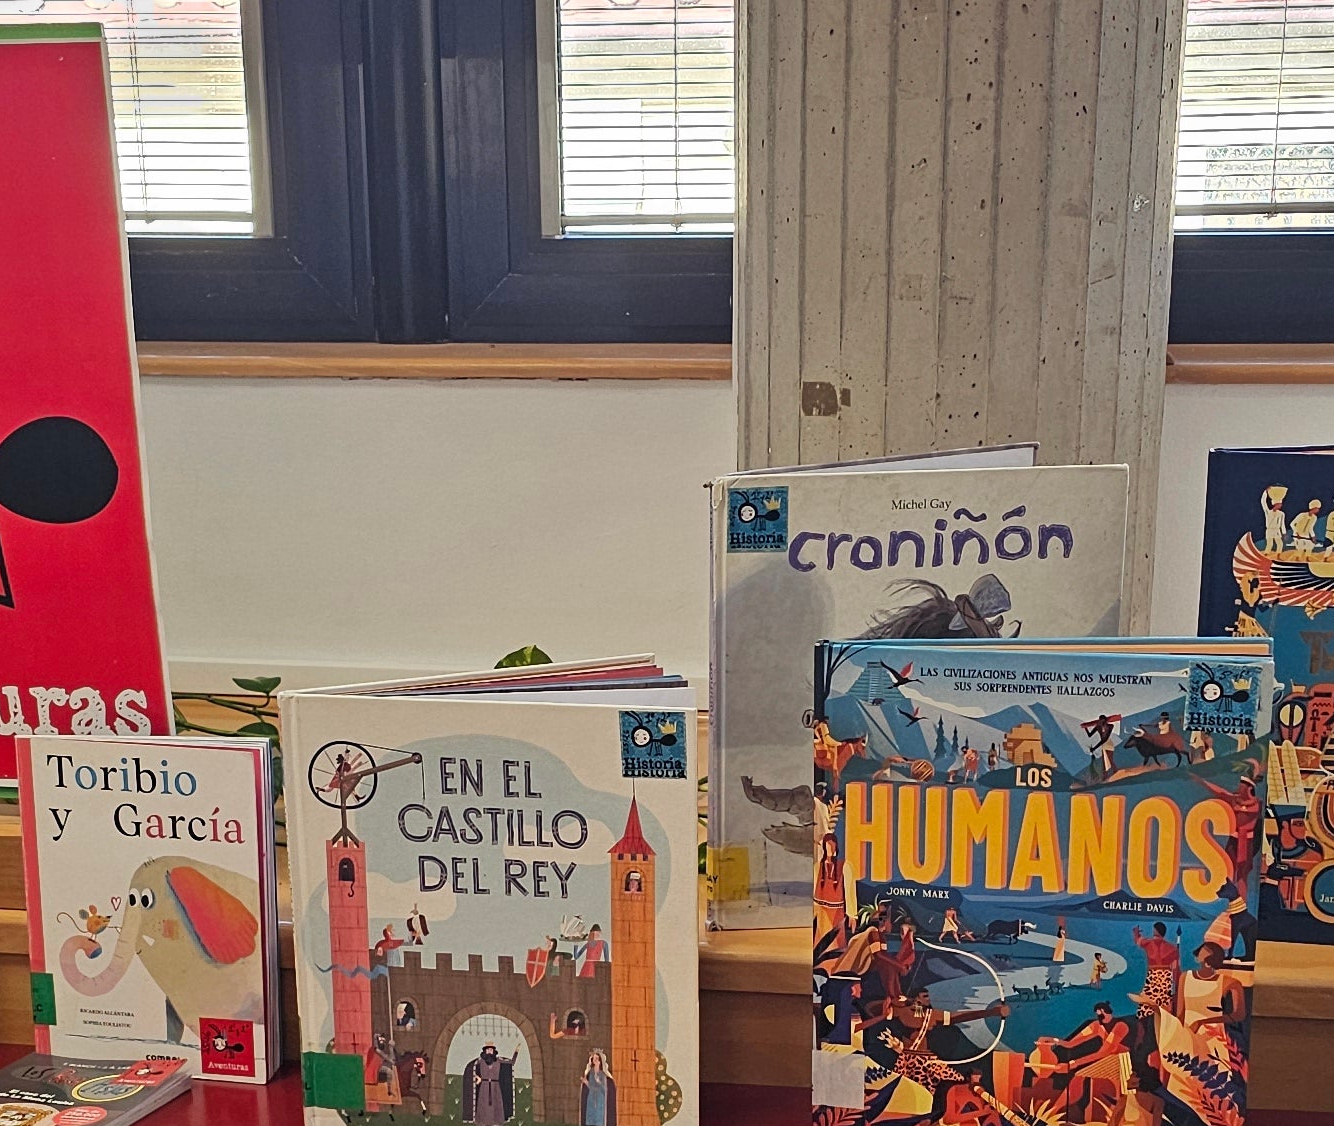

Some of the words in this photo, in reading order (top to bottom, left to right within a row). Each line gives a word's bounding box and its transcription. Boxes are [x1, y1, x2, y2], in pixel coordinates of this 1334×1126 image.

[890, 498, 928, 510] Michel
[929, 498, 952, 512] Gay
[788, 505, 1074, 573] croniñón
[920, 667, 938, 678] LAS
[943, 667, 1017, 681] CIVILIZACIONES
[1022, 671, 1069, 683] ANTIGUAS
[1073, 672, 1095, 684] NOS
[1098, 673, 1153, 686] MUESTRAN
[953, 681, 973, 693] SUS
[976, 682, 1053, 696] SORPRENDENTES
[1056, 686, 1116, 698] HALLAZGOS
[46, 754, 198, 797] Toribio
[440, 757, 483, 797] EN
[503, 760, 542, 798] EL
[1015, 767, 1053, 789] LOS
[49, 807, 72, 841] y
[113, 803, 246, 845] García
[398, 804, 588, 849] CASTILLO
[844, 781, 1238, 904] HUMANOS
[418, 855, 490, 895] DEL
[504, 858, 577, 898] REY
[886, 886, 919, 898] JONNY
[922, 888, 950, 900] MARX
[1103, 901, 1144, 913] CHARLIE
[1146, 903, 1175, 914] DAVIS
